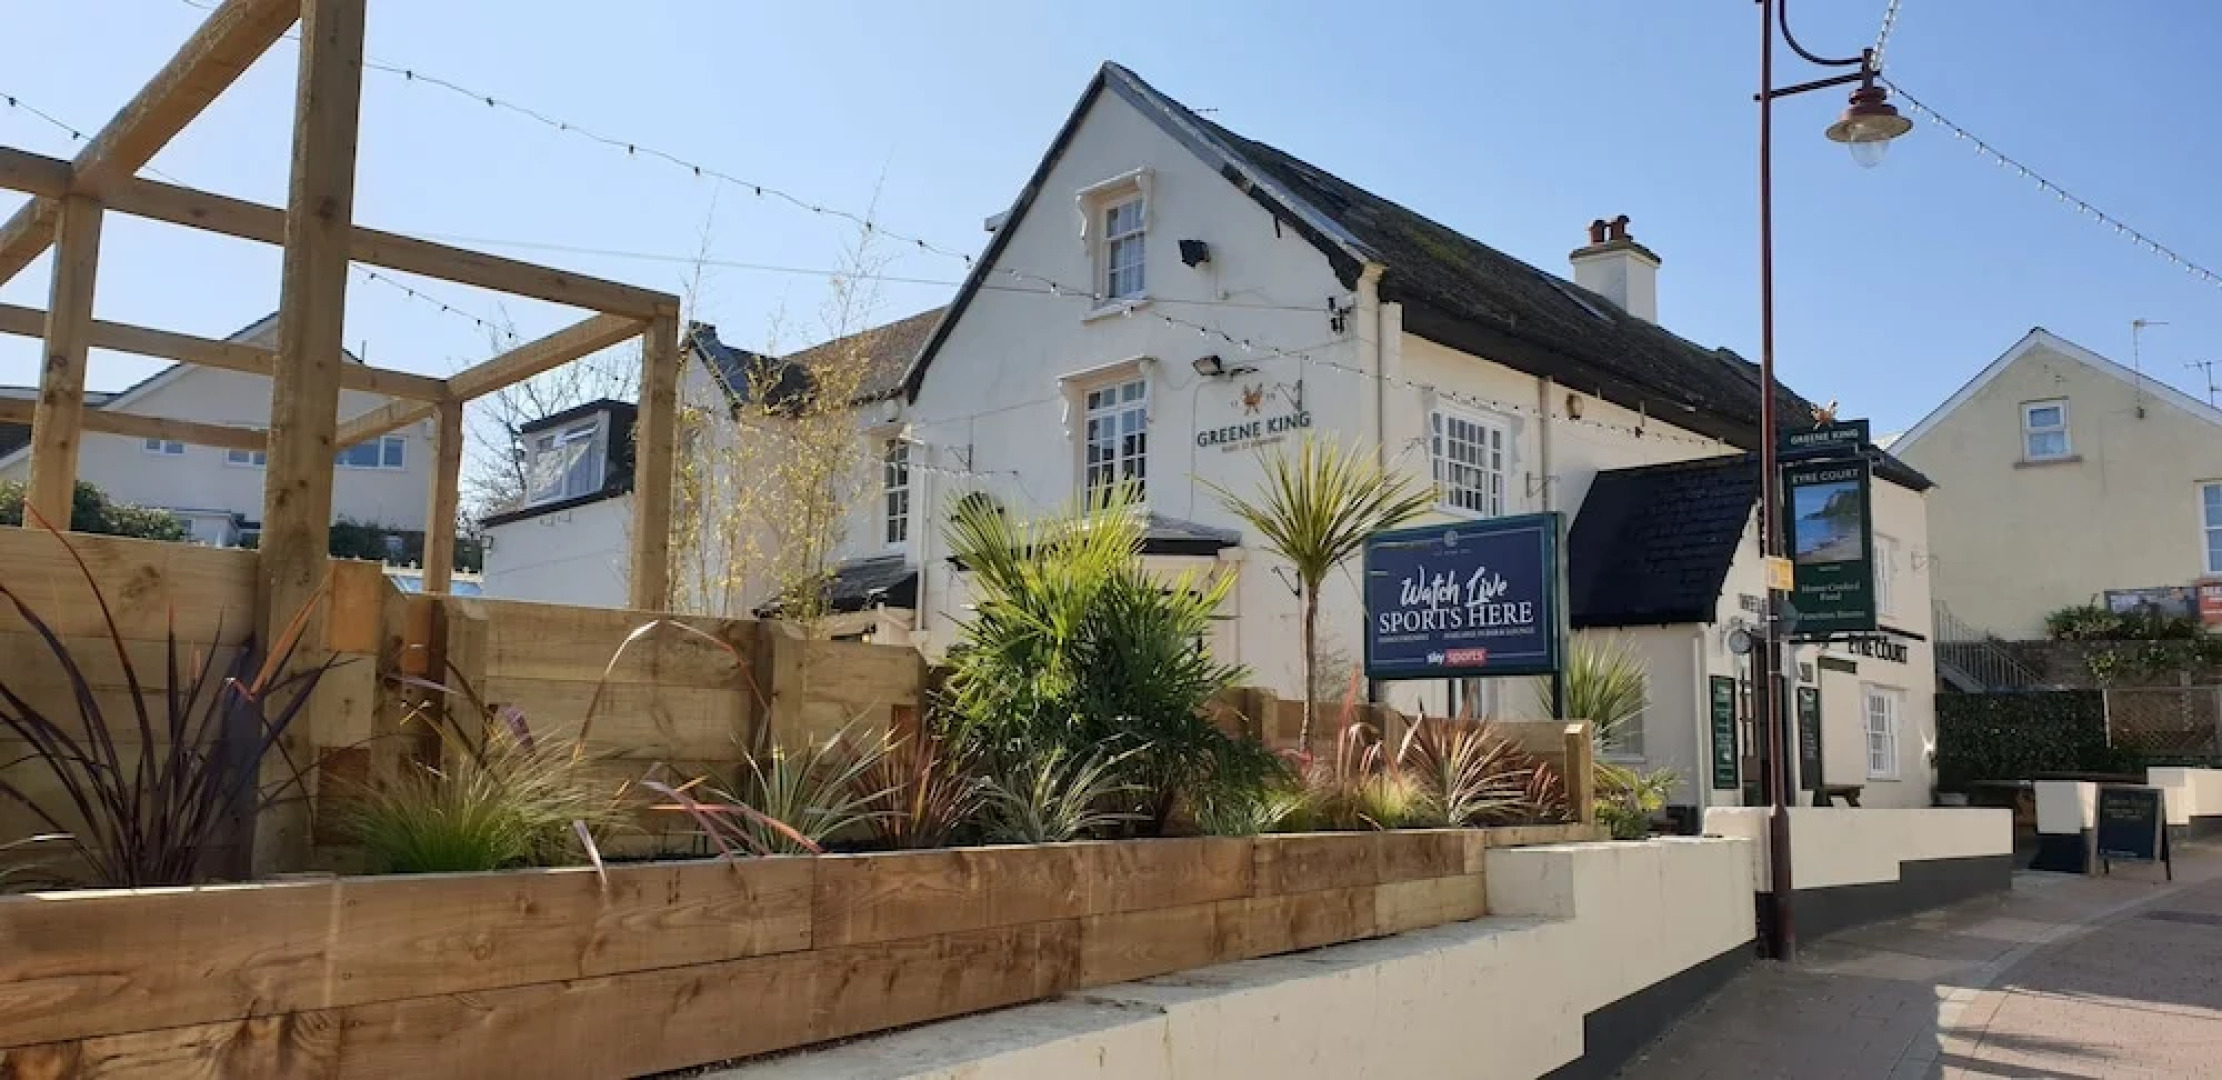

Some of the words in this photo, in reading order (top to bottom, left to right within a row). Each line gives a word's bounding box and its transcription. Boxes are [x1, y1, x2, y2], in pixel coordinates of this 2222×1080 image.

[1197, 421, 1261, 447] GREENE
[1266, 411, 1310, 434] KING
[1790, 432, 1829, 445] GREENE
[1832, 428, 1858, 439] KING
[1793, 472, 1817, 483] EYRE
[1820, 469, 1859, 481] COURT
[1400, 564, 1460, 611] Watch
[1464, 566, 1508, 607] Live
[1379, 608, 1462, 635] SPORTS
[1468, 602, 1534, 628] HERE
[1426, 651, 1444, 665] sky
[1447, 650, 1484, 662] sports
[1875, 635, 1907, 664] COURT
